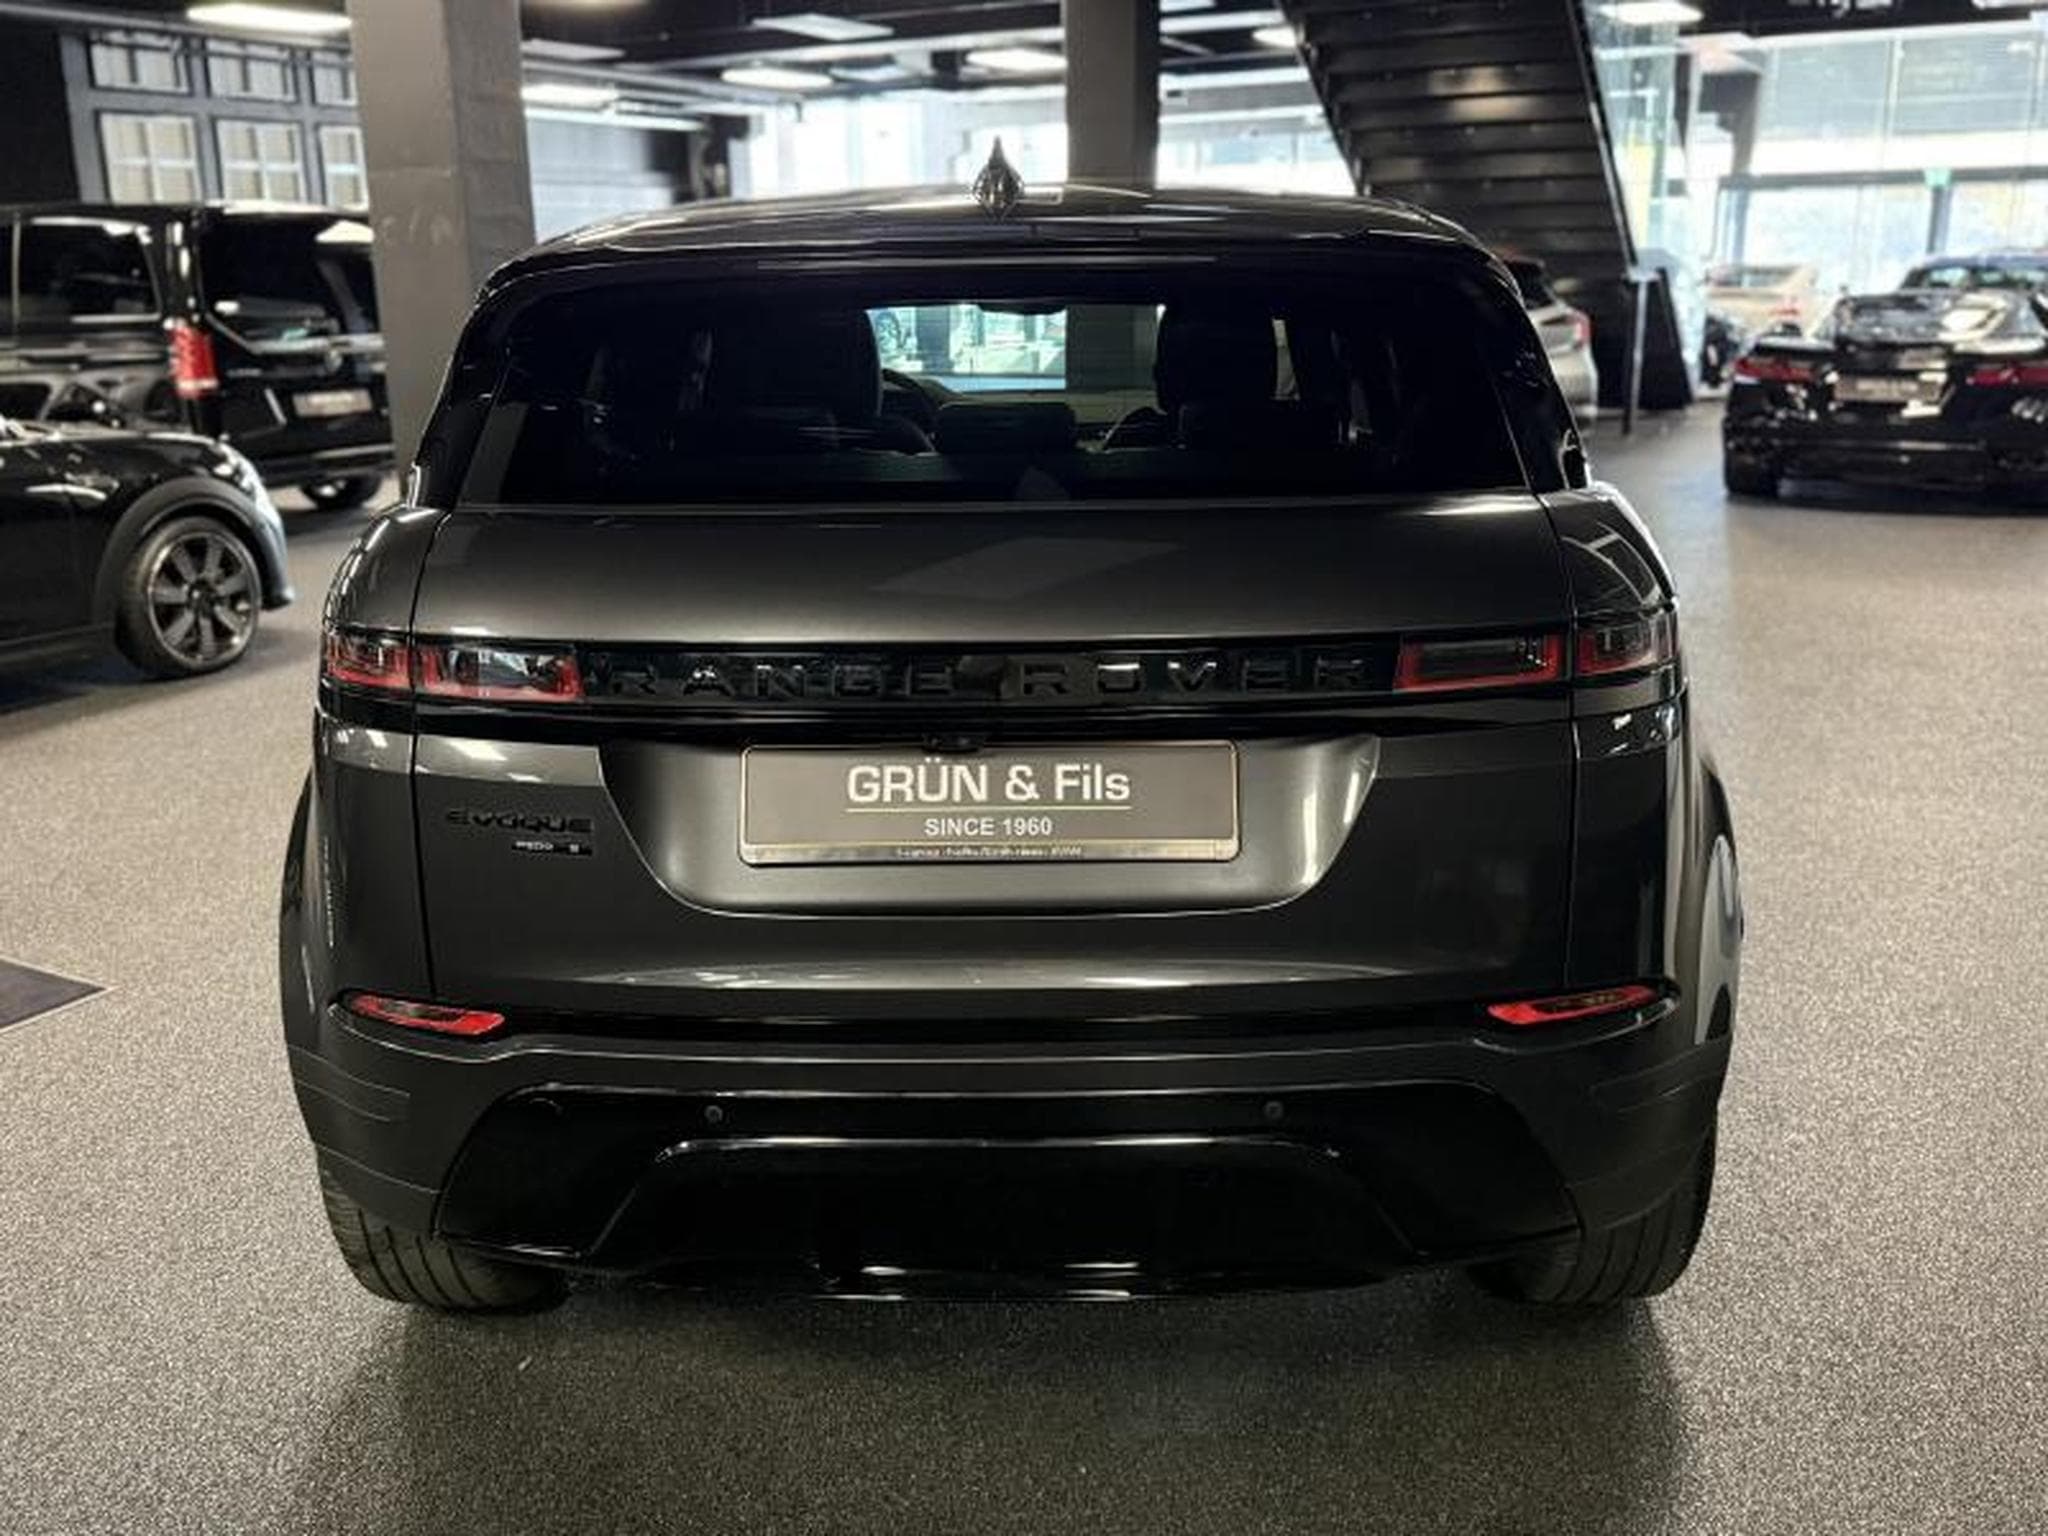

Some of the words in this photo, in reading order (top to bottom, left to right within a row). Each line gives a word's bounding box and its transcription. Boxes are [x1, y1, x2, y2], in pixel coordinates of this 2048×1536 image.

[609, 661, 954, 698] RANGE
[1018, 656, 1366, 697] ROVER
[847, 757, 989, 803] GRÜN
[1005, 765, 1040, 801] &
[1055, 764, 1131, 801] Fils
[924, 817, 994, 837] SINCE
[1002, 817, 1053, 837] 1960
